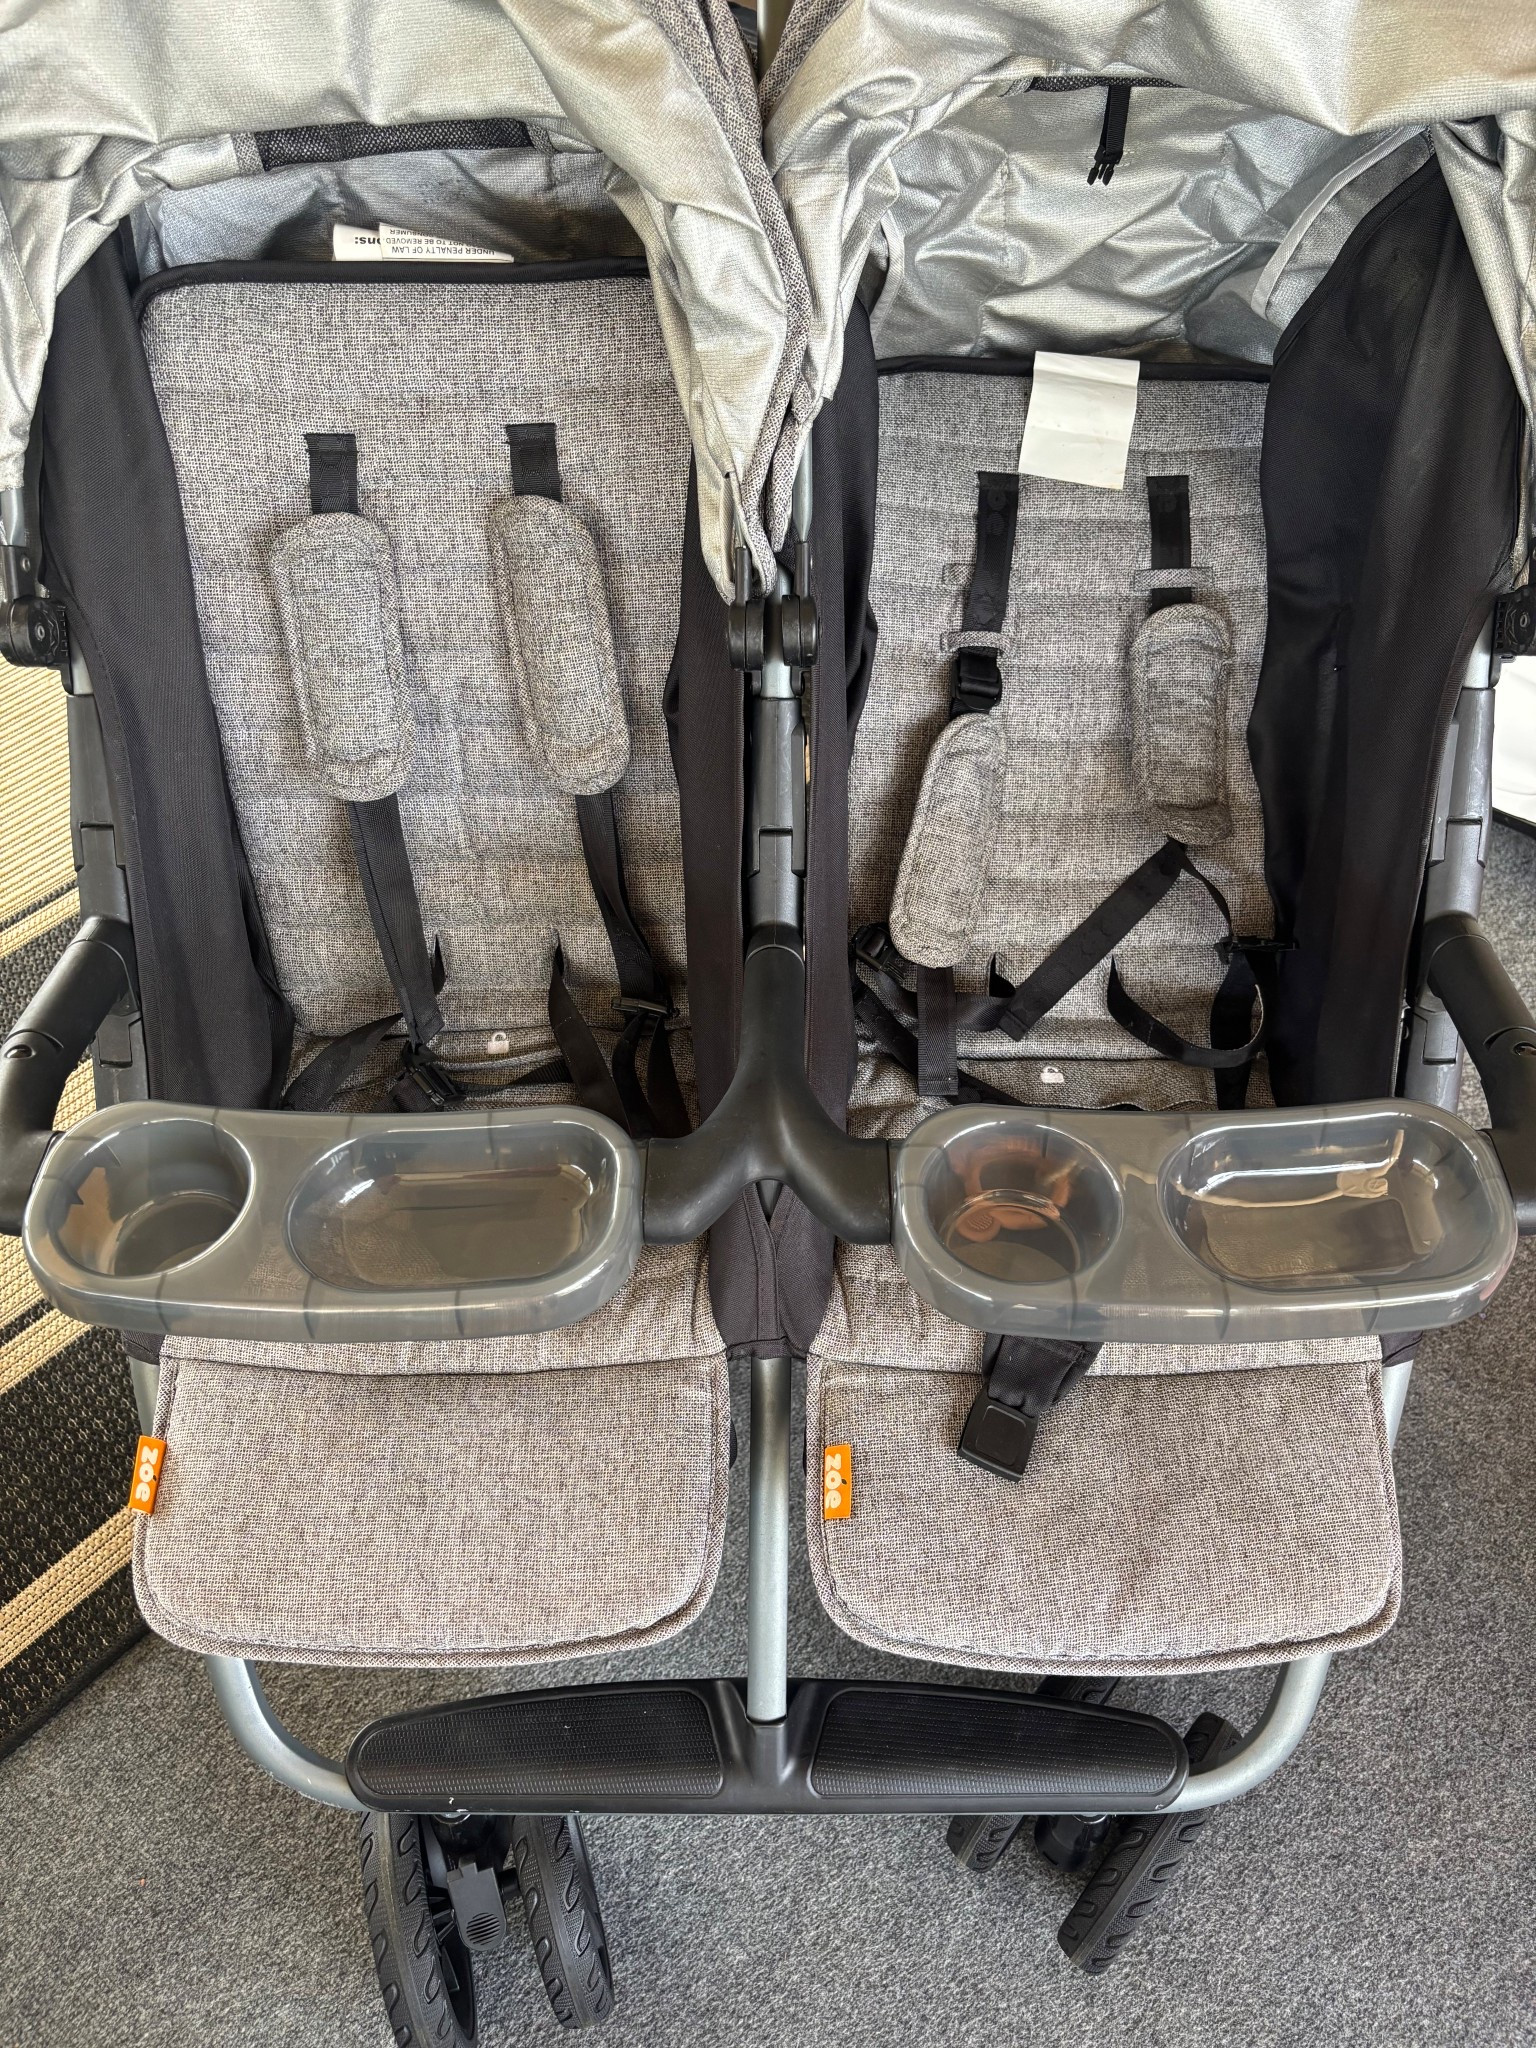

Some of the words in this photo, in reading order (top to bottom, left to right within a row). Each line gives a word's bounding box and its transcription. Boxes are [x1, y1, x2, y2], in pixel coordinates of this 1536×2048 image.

[391, 246, 410, 254] LAW
[412, 246, 424, 254] OF
[425, 246, 463, 254] PENALTY
[465, 246, 495, 255] UNDER
